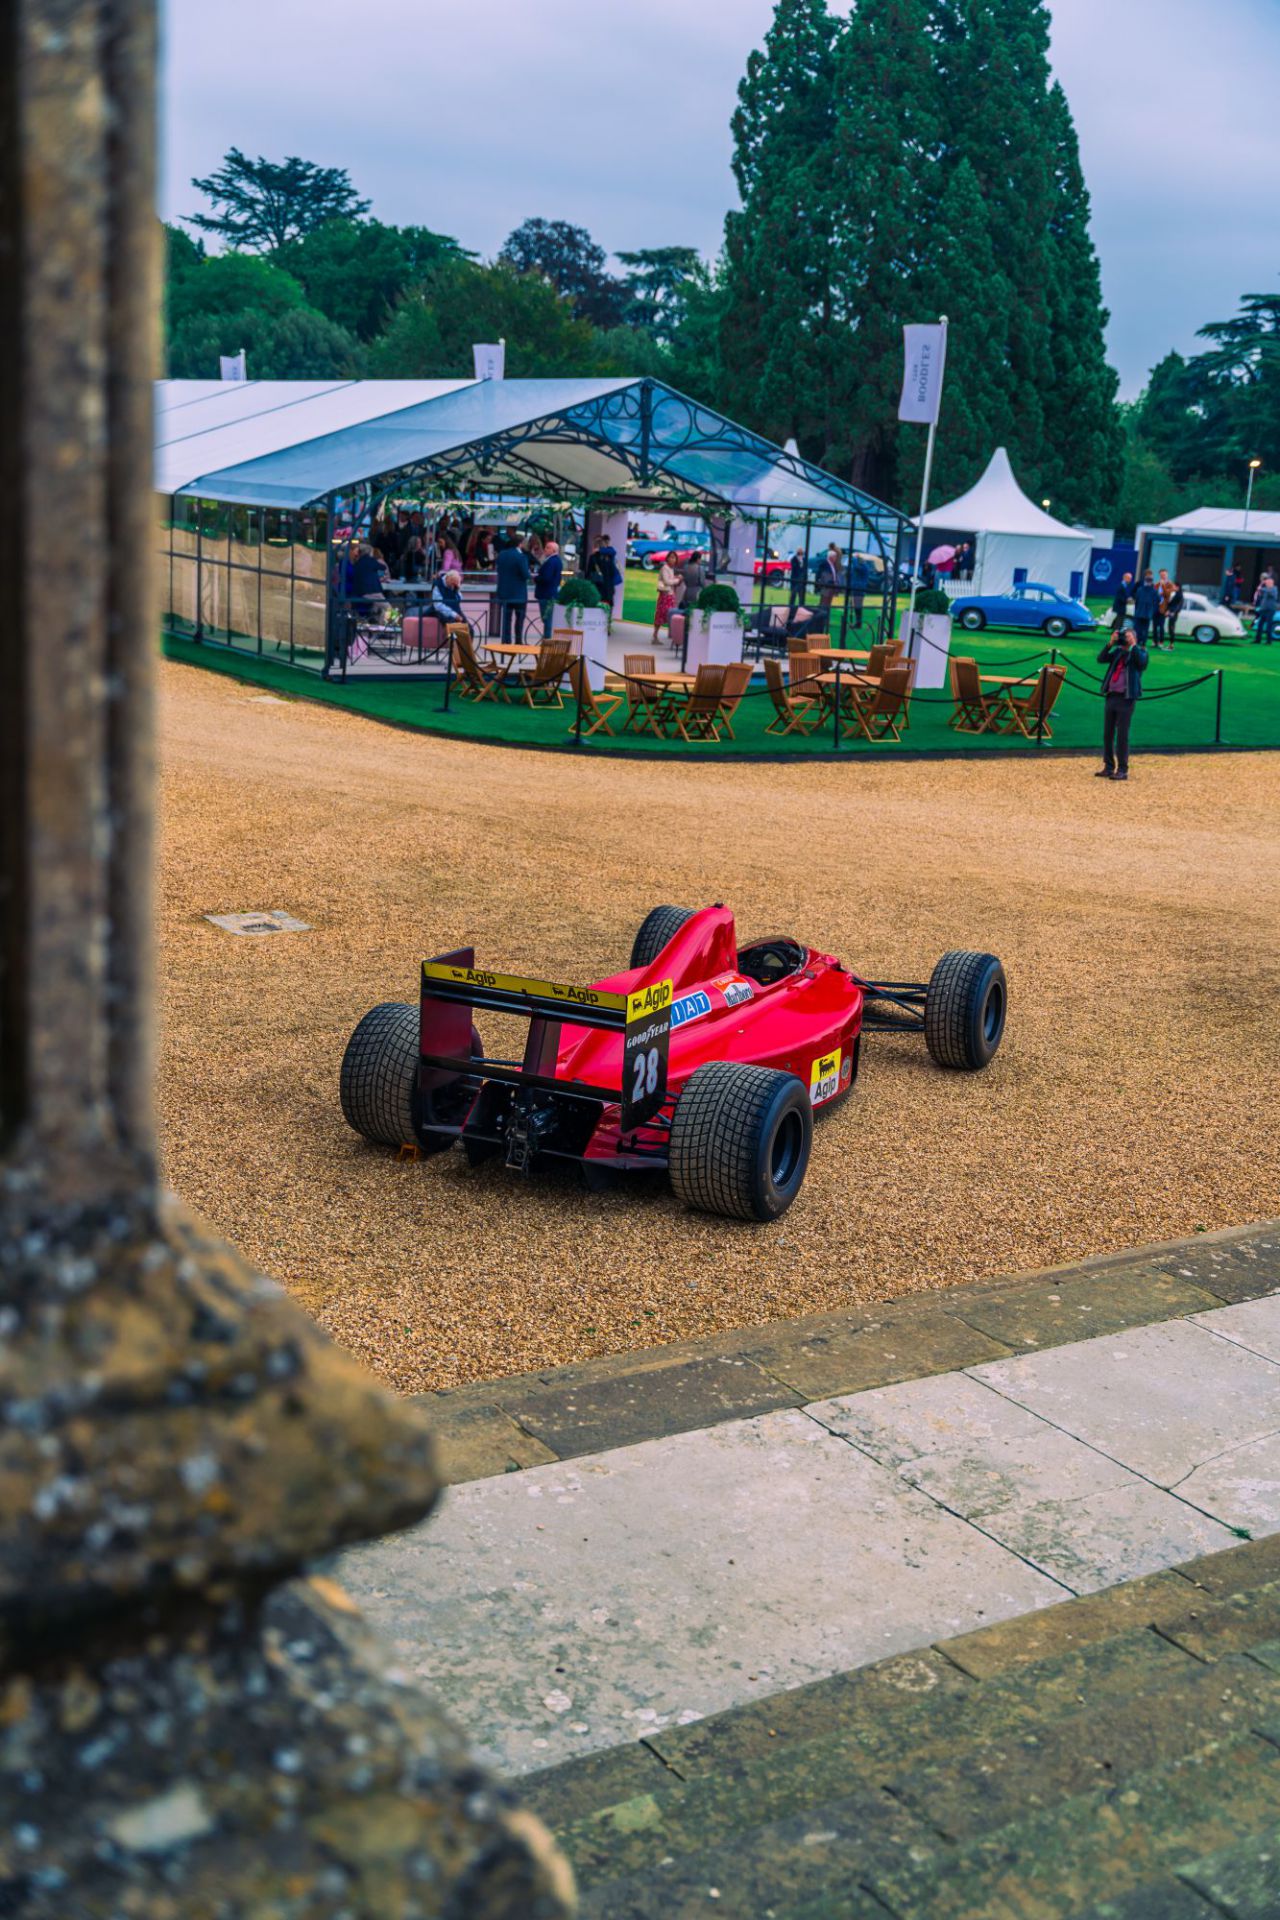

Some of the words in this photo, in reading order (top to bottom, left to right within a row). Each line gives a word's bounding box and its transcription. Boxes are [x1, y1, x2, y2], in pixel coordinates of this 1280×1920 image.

[466, 970, 497, 987] Agip
[567, 987, 599, 1004] Agip
[643, 982, 669, 1011] Agip
[674, 994, 706, 1021] IAT
[631, 1047, 659, 1104] 28
[814, 1077, 836, 1100] Agip
